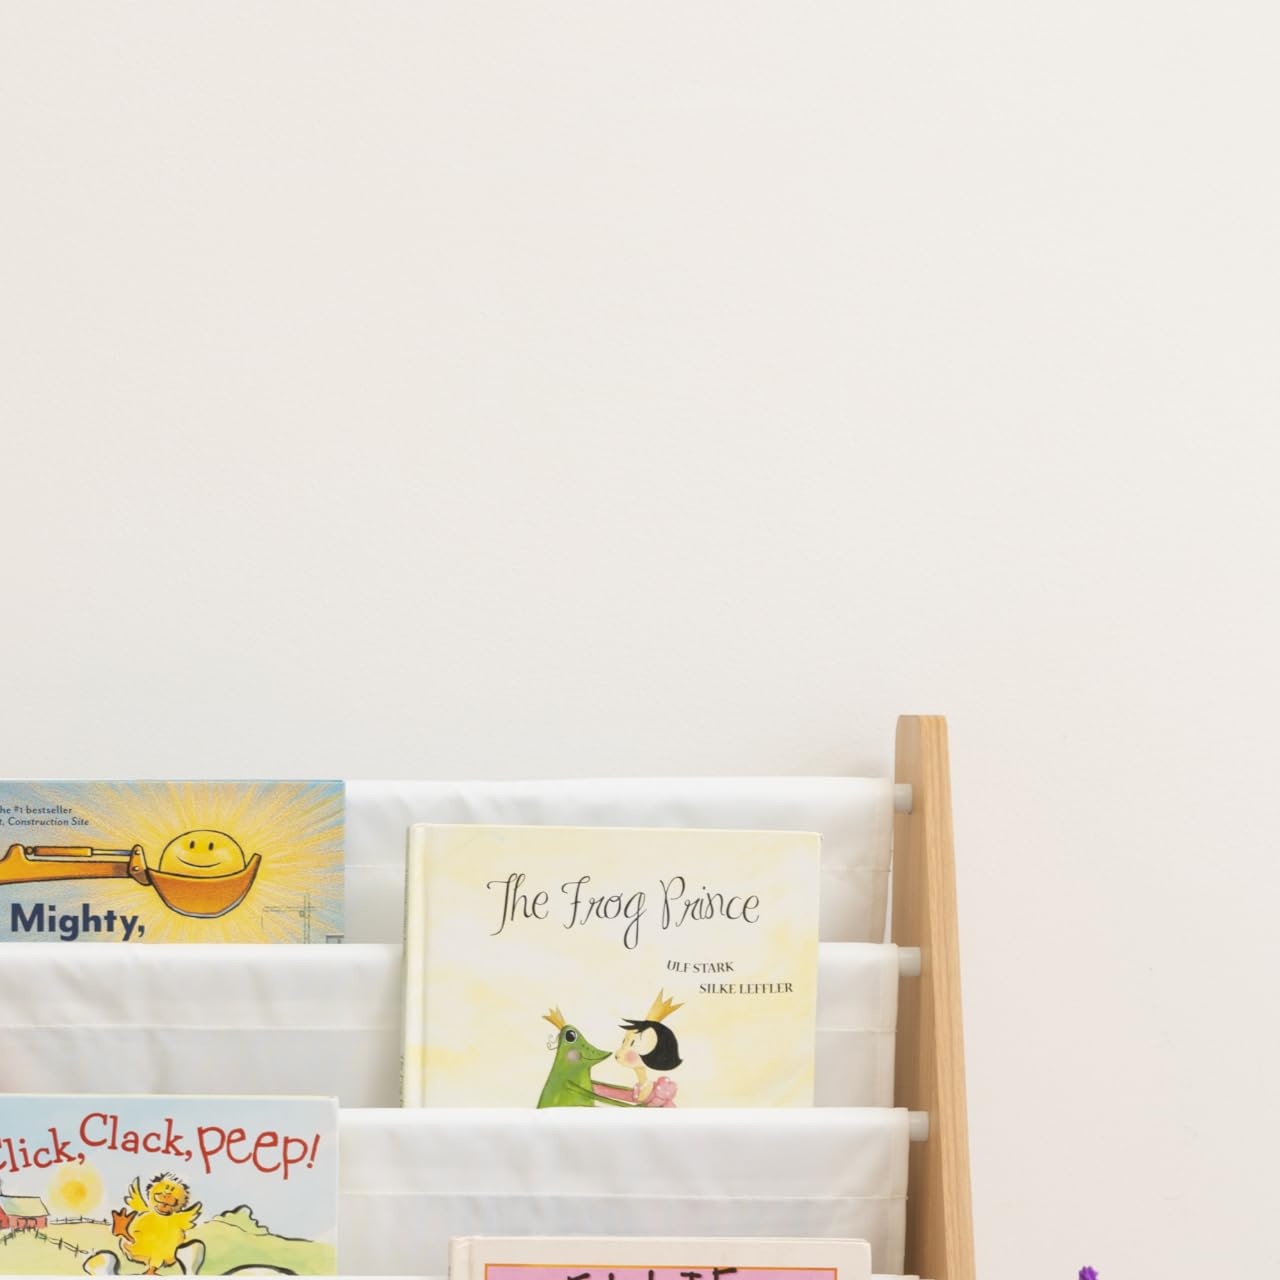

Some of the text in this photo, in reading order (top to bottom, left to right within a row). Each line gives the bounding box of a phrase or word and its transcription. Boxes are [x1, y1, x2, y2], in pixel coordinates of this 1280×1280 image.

[26, 804, 73, 814] bestseller
[8, 816, 69, 826] Construction
[71, 816, 90, 826] Site
[486, 872, 760, 950] The Frog Prince
[11, 903, 146, 941] Mighty,
[666, 959, 734, 973] ULF STARK
[699, 982, 794, 994] SILKE LEFFLER
[79, 1112, 193, 1162] Clack,
